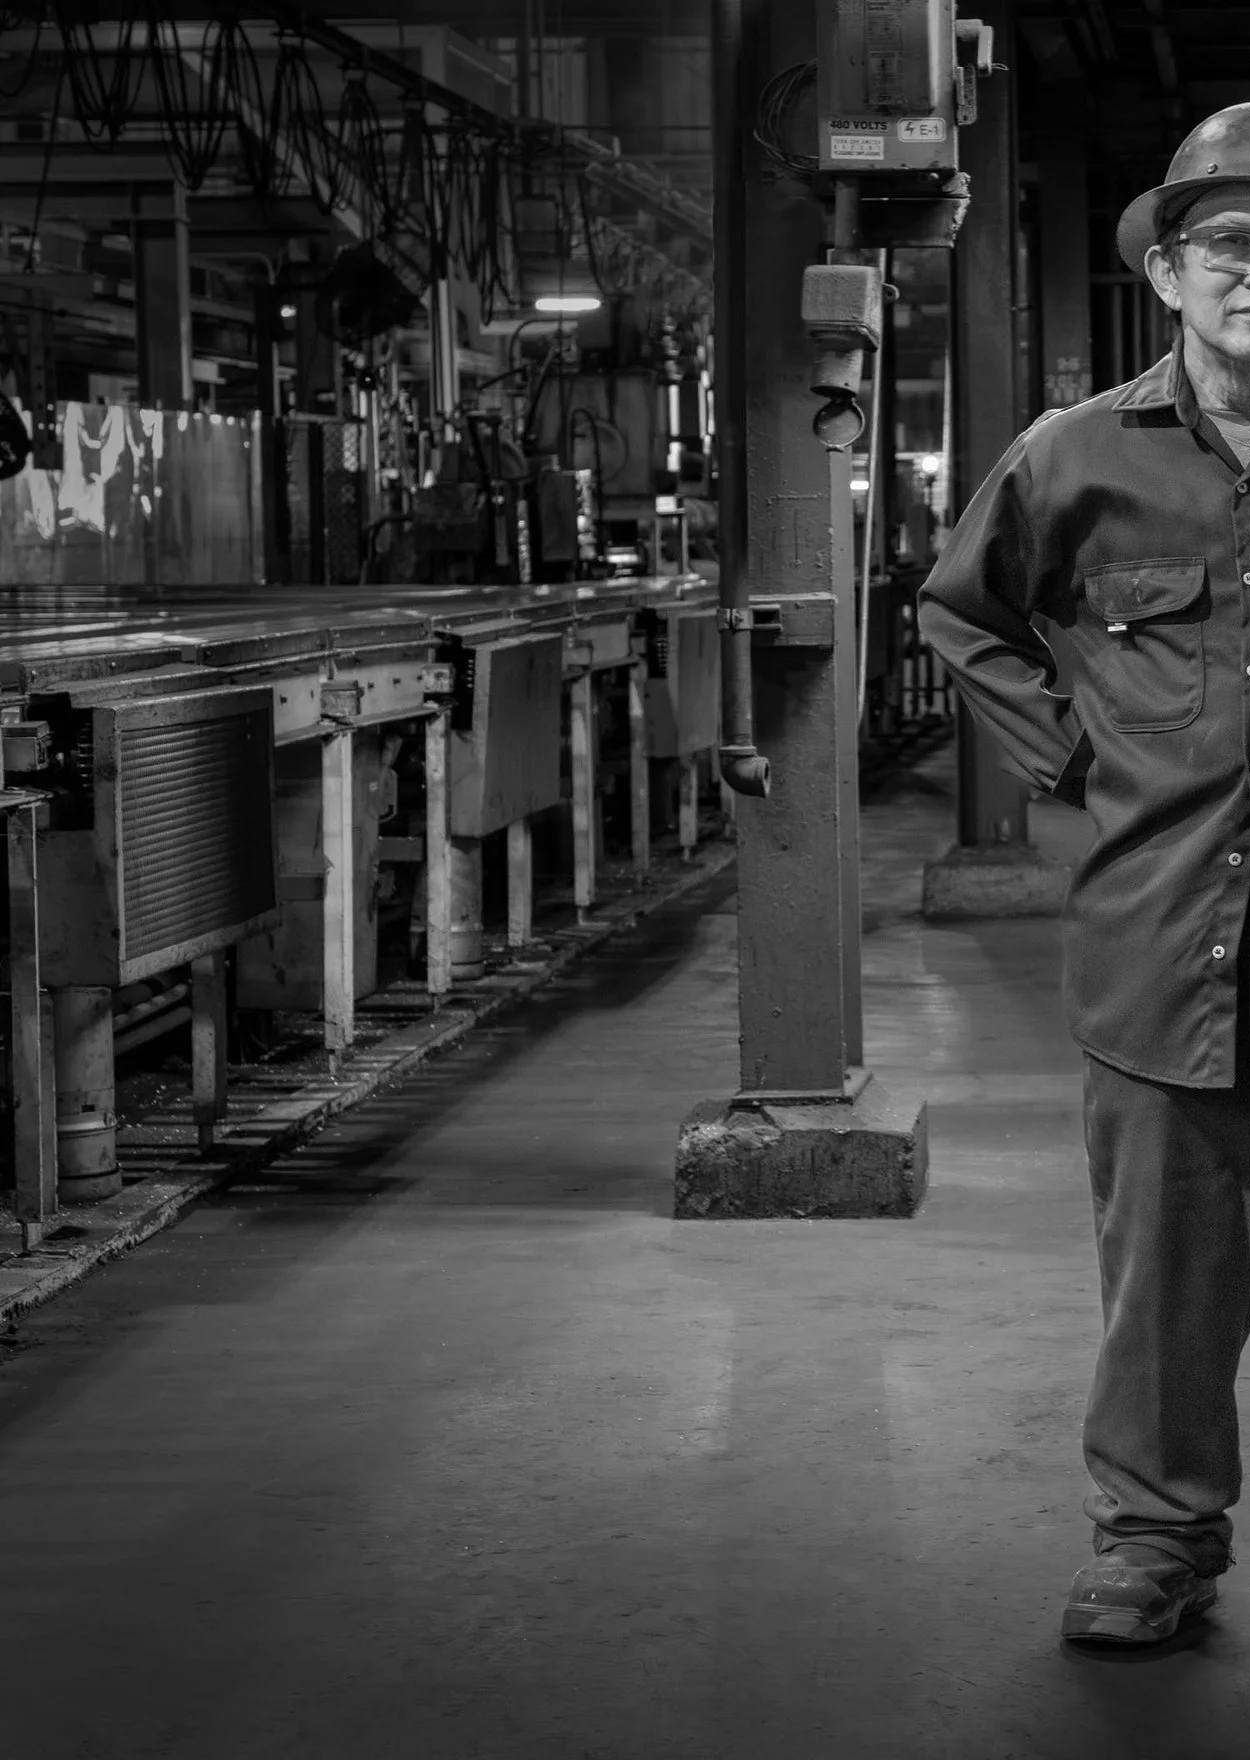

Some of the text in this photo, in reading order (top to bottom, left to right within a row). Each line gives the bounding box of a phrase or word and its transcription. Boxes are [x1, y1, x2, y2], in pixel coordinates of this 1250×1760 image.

[830, 120, 888, 131] 480 VOLTS
[920, 124, 940, 136] E-1
